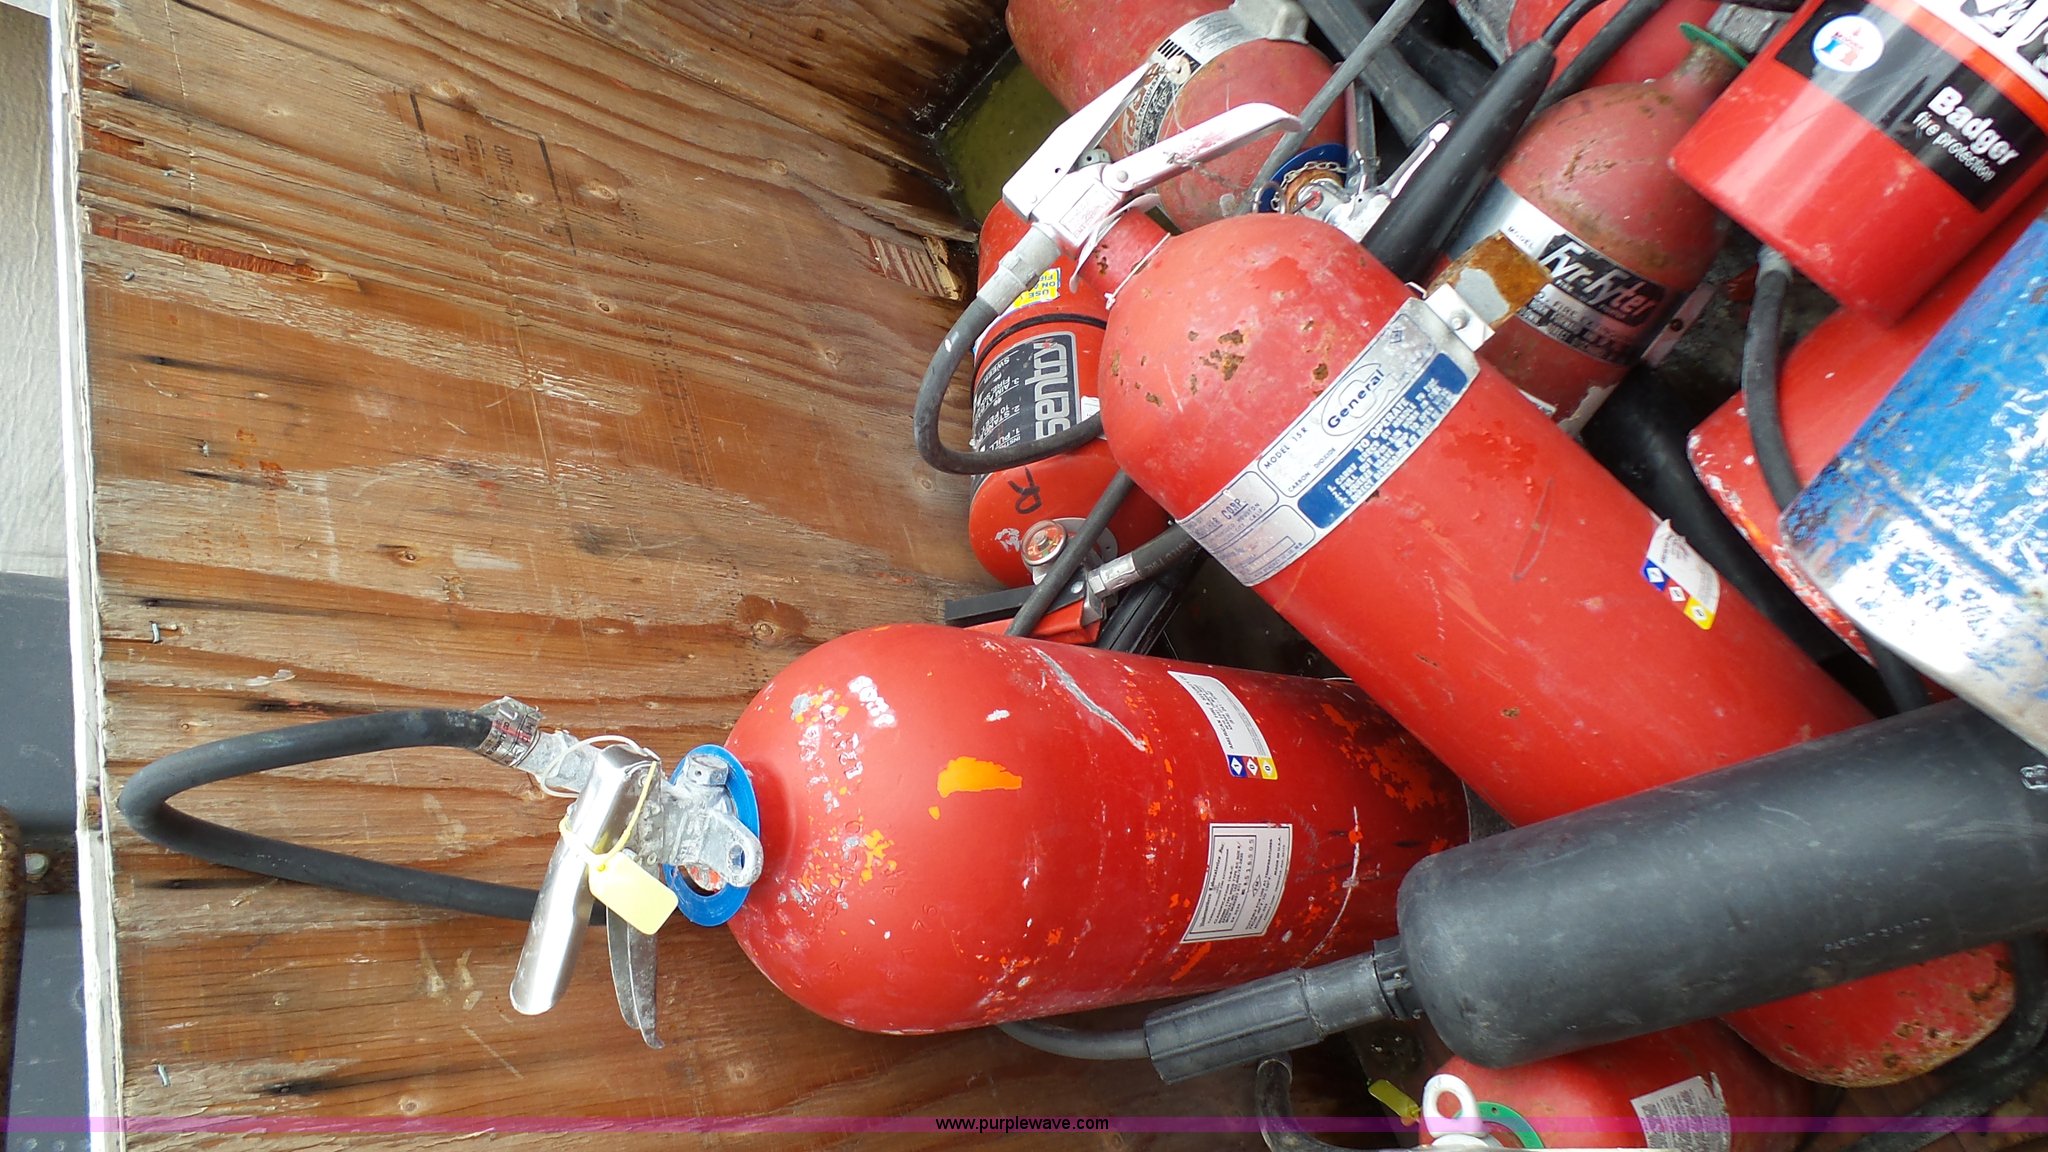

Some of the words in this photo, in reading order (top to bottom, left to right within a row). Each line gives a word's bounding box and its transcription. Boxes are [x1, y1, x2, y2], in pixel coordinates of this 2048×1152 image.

[1912, 110, 1940, 136] fire
[1932, 131, 1996, 182] protection
[1927, 86, 2020, 166] Badger
[1539, 240, 1656, 317] Fyr-Fyter
[1324, 368, 1385, 429] General
[1354, 437, 1370, 453] TO
[1368, 397, 1410, 439] OPERATE
[1263, 442, 1290, 469] MODEL
[1008, 467, 1043, 514] R
